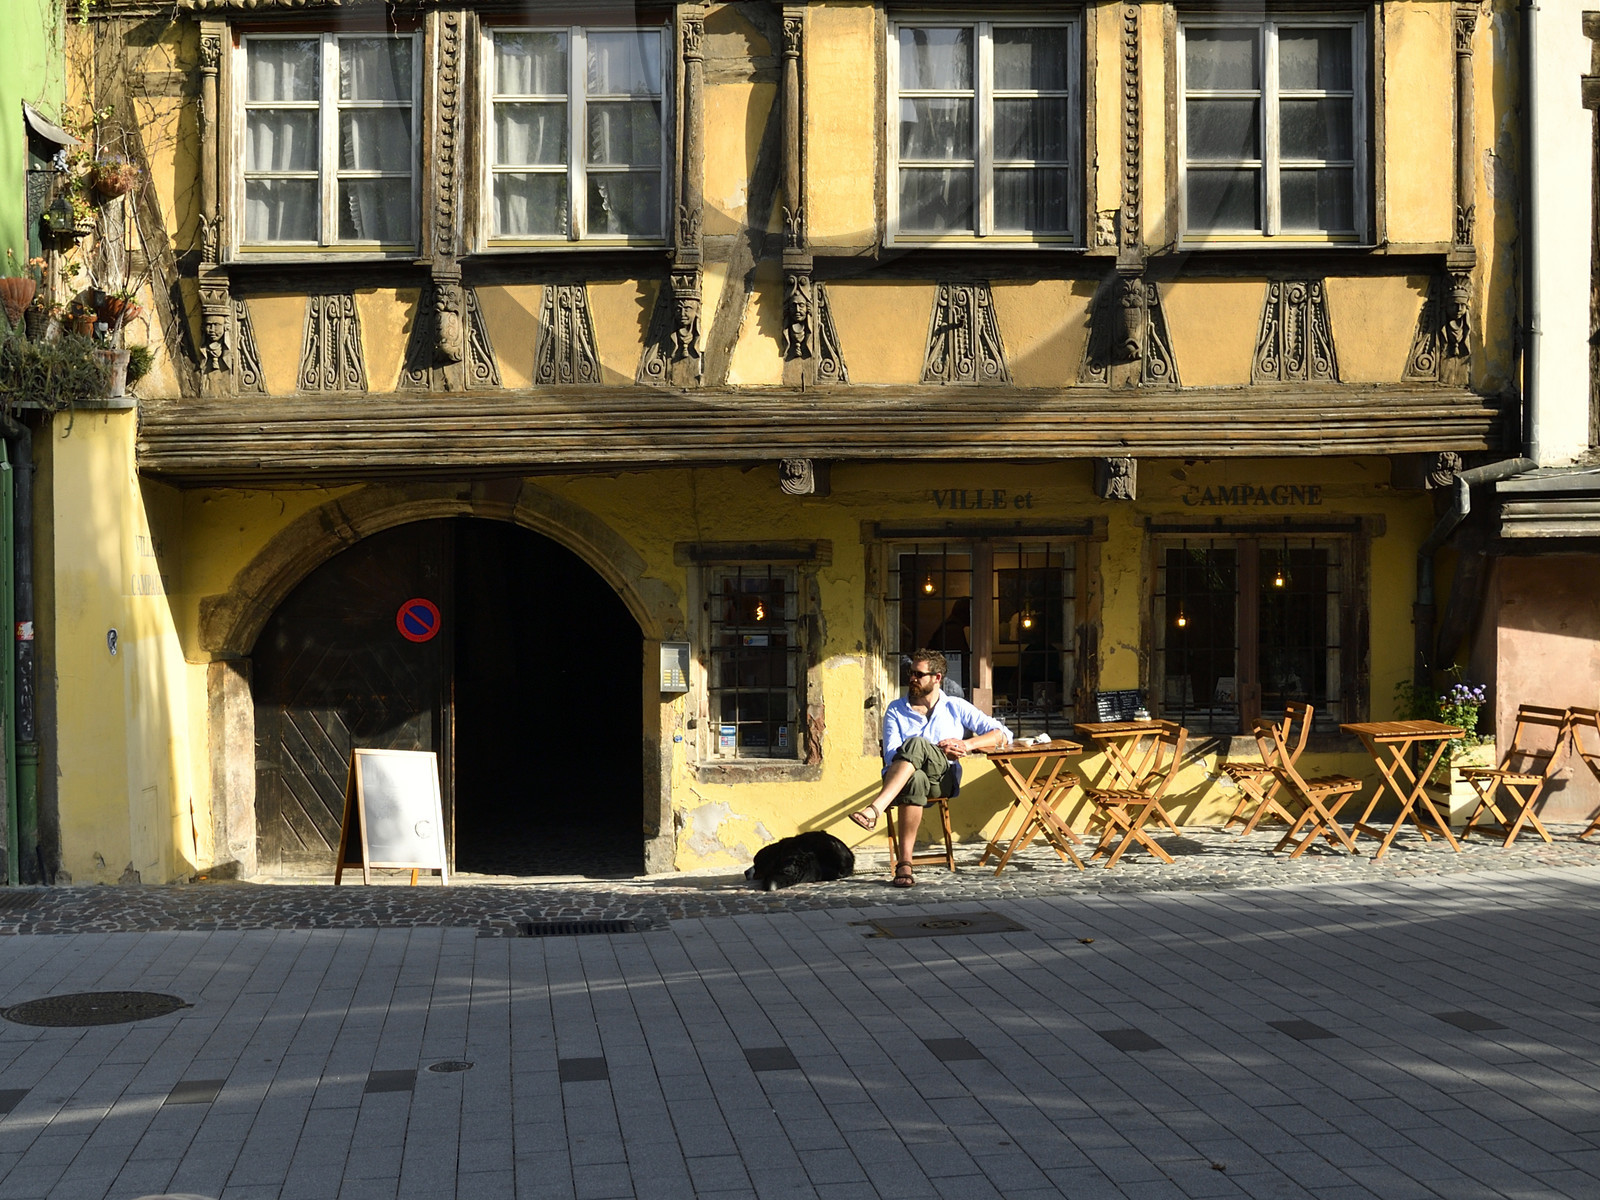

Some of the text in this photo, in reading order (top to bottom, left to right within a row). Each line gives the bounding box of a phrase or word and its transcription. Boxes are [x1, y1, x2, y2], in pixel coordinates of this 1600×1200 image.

[931, 488, 1034, 510] VILLE et
[1181, 484, 1324, 507] CAMPAGNE
